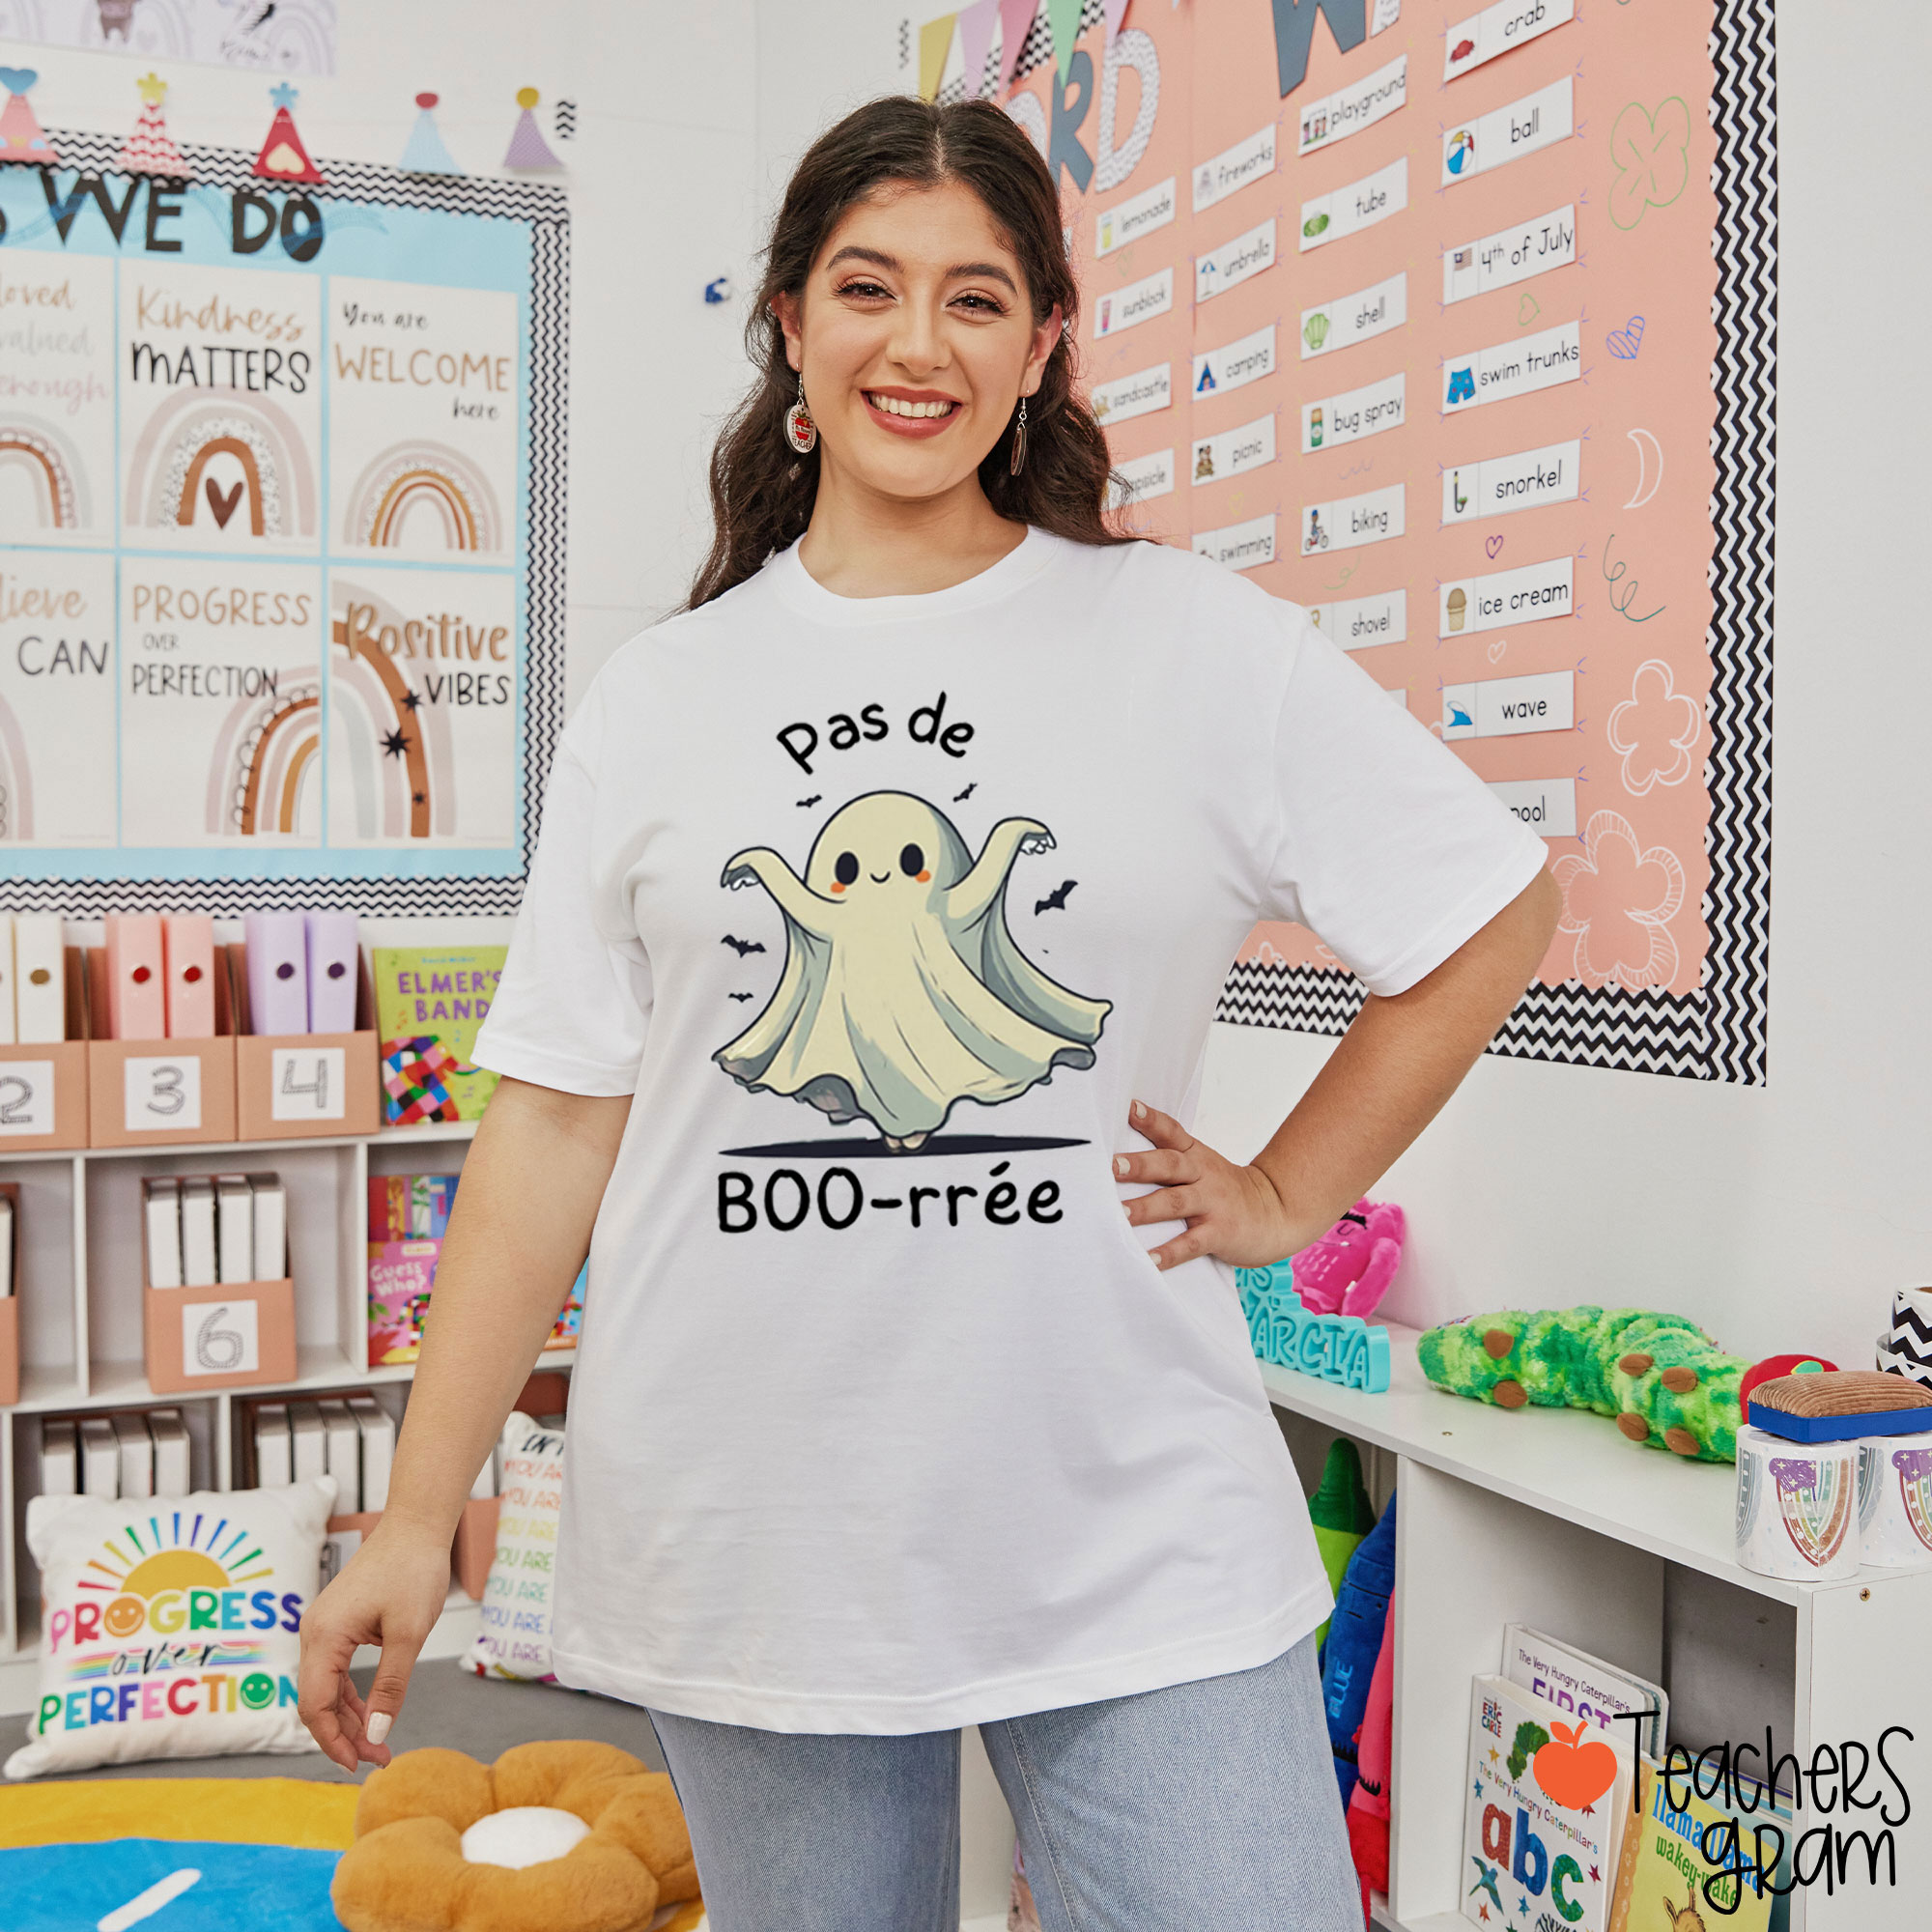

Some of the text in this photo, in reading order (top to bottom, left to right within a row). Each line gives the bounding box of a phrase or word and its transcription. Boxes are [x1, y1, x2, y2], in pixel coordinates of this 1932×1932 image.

[1504, 0, 1546, 37] crab
[1330, 64, 1406, 131] playground
[1510, 106, 1540, 144] ball
[1218, 143, 1273, 186] fireworks
[40, 169, 185, 253] WE
[232, 188, 324, 263] DO
[1121, 193, 1172, 233] lemonade
[1355, 188, 1387, 218] tube
[1224, 238, 1270, 277] umbrella
[1481, 223, 1574, 273] 4th of July
[136, 287, 304, 341] Kindness
[344, 302, 428, 329] You are
[1355, 296, 1385, 329] shell
[335, 342, 512, 391] WELCOME
[1226, 349, 1269, 379] camping
[1480, 340, 1579, 386] swim trunks
[453, 397, 499, 420] here
[1113, 374, 1169, 409] sandcastle
[1334, 397, 1403, 433] bug spray
[1232, 439, 1264, 469] picnic
[1495, 459, 1562, 498] snorkel
[1351, 508, 1388, 533] biking
[1219, 534, 1272, 563] swimming
[133, 584, 311, 626] PROGRESS
[1478, 582, 1569, 617] ice cream
[346, 601, 509, 662] Positive
[1351, 606, 1391, 637] shovel
[17, 636, 107, 675] CAN
[144, 633, 180, 651] OVER
[132, 663, 278, 697] PERFECTION
[426, 673, 512, 705] VIBES
[907, 690, 976, 758] de
[1501, 698, 1548, 720] wave
[415, 999, 491, 1023] BAND
[0, 1075, 33, 1124] 2
[147, 1065, 185, 1116] 3
[280, 1058, 327, 1109] 4
[718, 1161, 1065, 1234] BOO-rrée
[370, 1261, 423, 1282] Guess
[375, 1275, 427, 1297] Who?
[196, 1306, 244, 1370] 6
[1244, 1299, 1370, 1388] ARCIA
[50, 1590, 303, 1655] PROGRESS
[513, 1611, 546, 1634] ARE
[112, 1641, 249, 1676] over
[1519, 1648, 1631, 1714] The Very Hungry Caterpillar's
[39, 1672, 299, 1735] PERFECTION
[1479, 1760, 1492, 1779] The
[1494, 1772, 1512, 1797] Very
[1513, 1786, 1543, 1819] Hungry
[1544, 1809, 1598, 1855] Caterpillar's
[1482, 1803, 1585, 1922] abc
